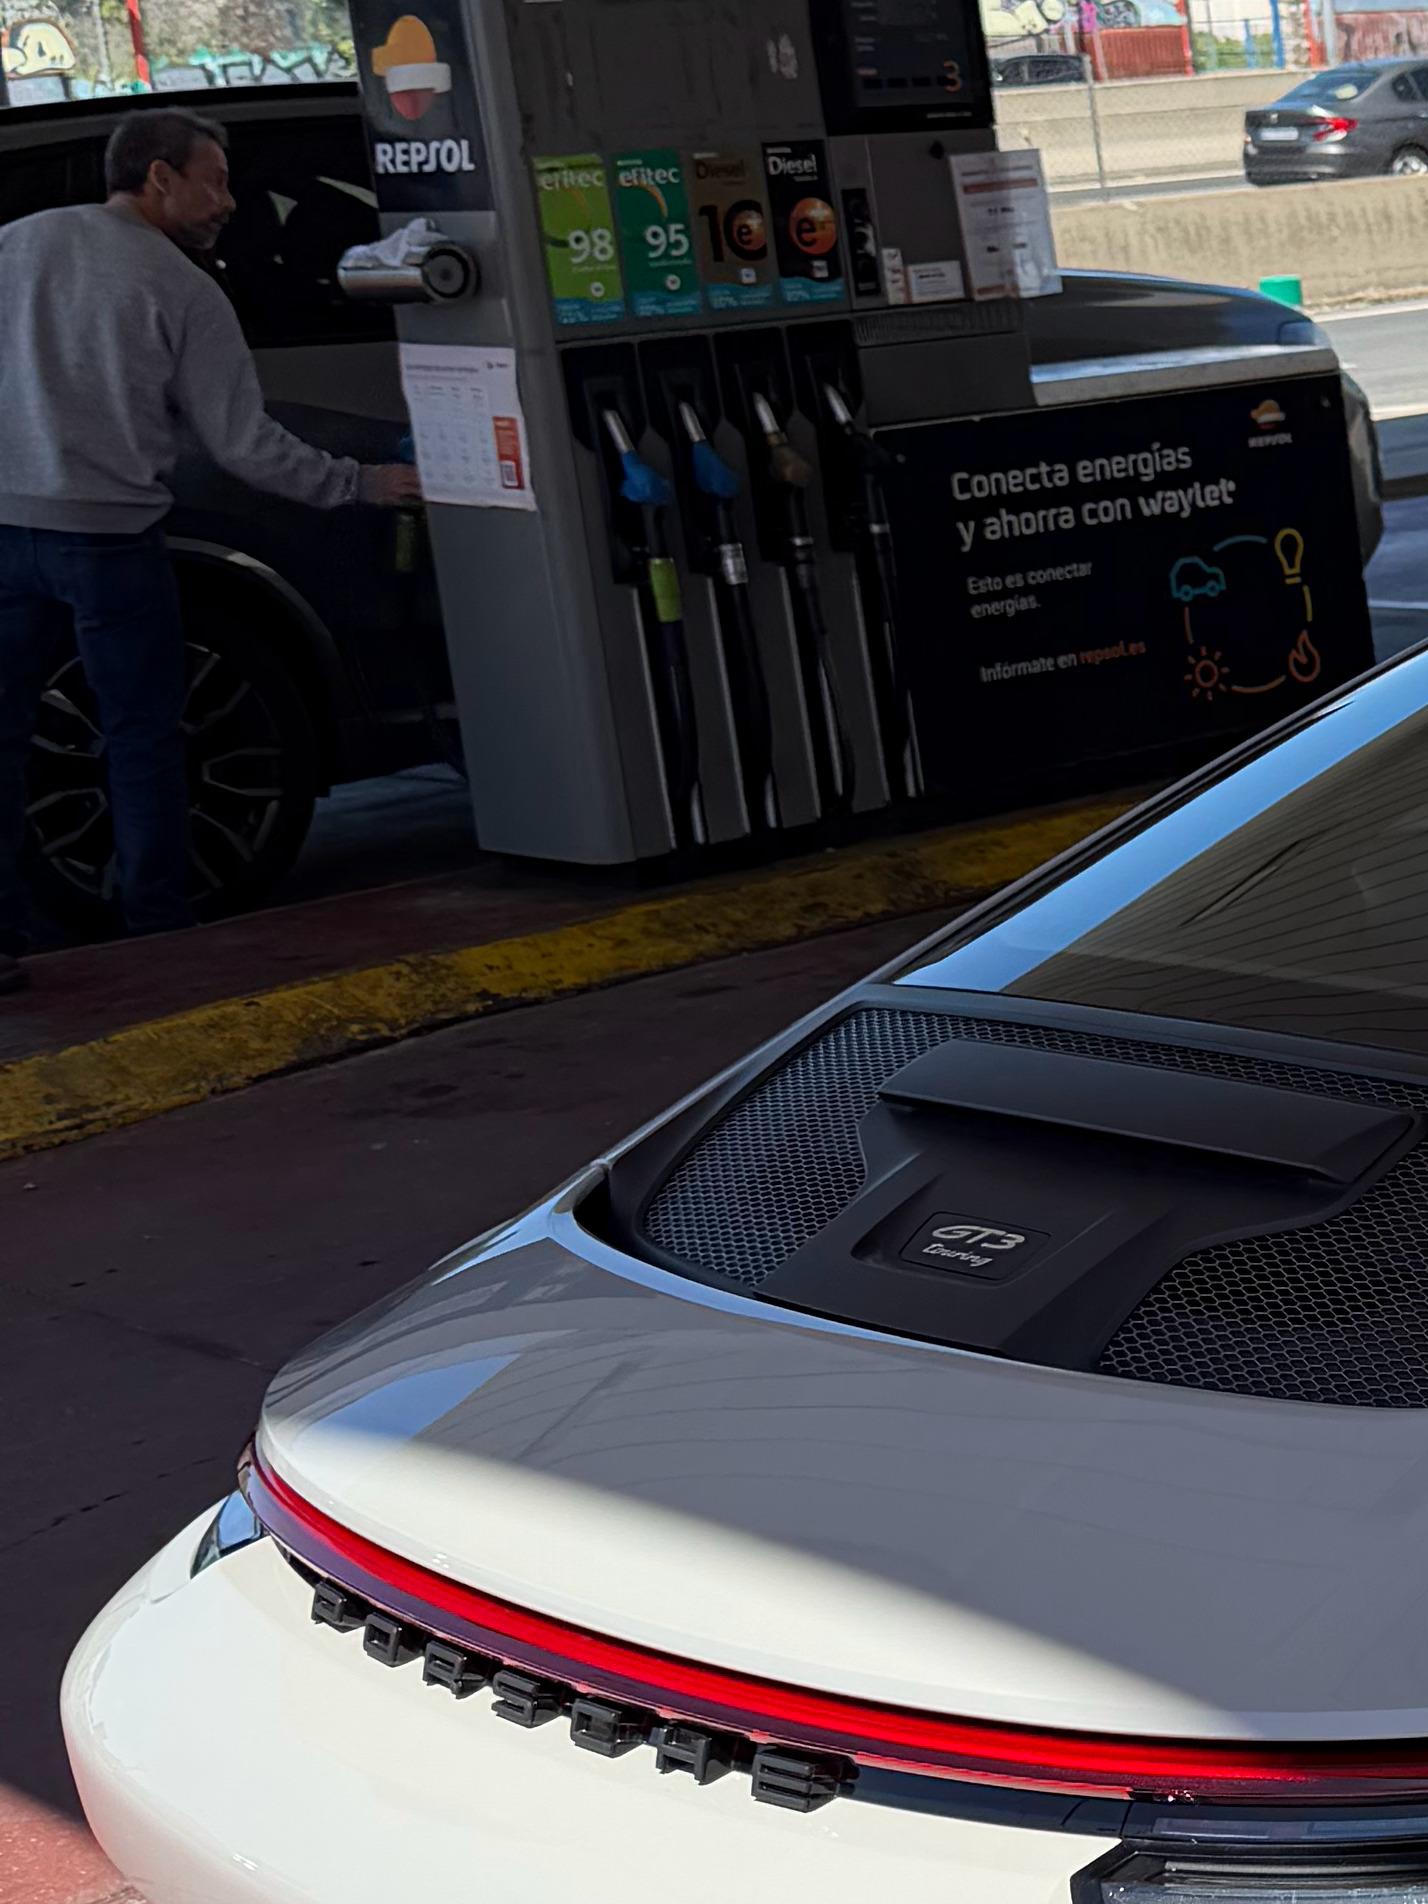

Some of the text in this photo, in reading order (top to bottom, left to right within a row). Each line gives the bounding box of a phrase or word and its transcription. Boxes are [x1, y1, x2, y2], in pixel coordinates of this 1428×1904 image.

[943, 59, 963, 94] 3
[375, 139, 475, 175] REPSOL
[767, 154, 817, 175] Diesel
[617, 167, 681, 187] efitec
[568, 228, 614, 263] 98
[645, 223, 690, 258] 95
[951, 441, 1192, 502] Conecta energías
[956, 519, 976, 552] y
[982, 507, 1076, 542] ahorra
[1081, 497, 1133, 526] con
[966, 559, 1093, 596] Esto es conectar
[979, 652, 1056, 683] Infórmate
[1057, 650, 1078, 670] en
[932, 1224, 1026, 1250] GT3
[311, 1581, 838, 1813] PORSCHE
